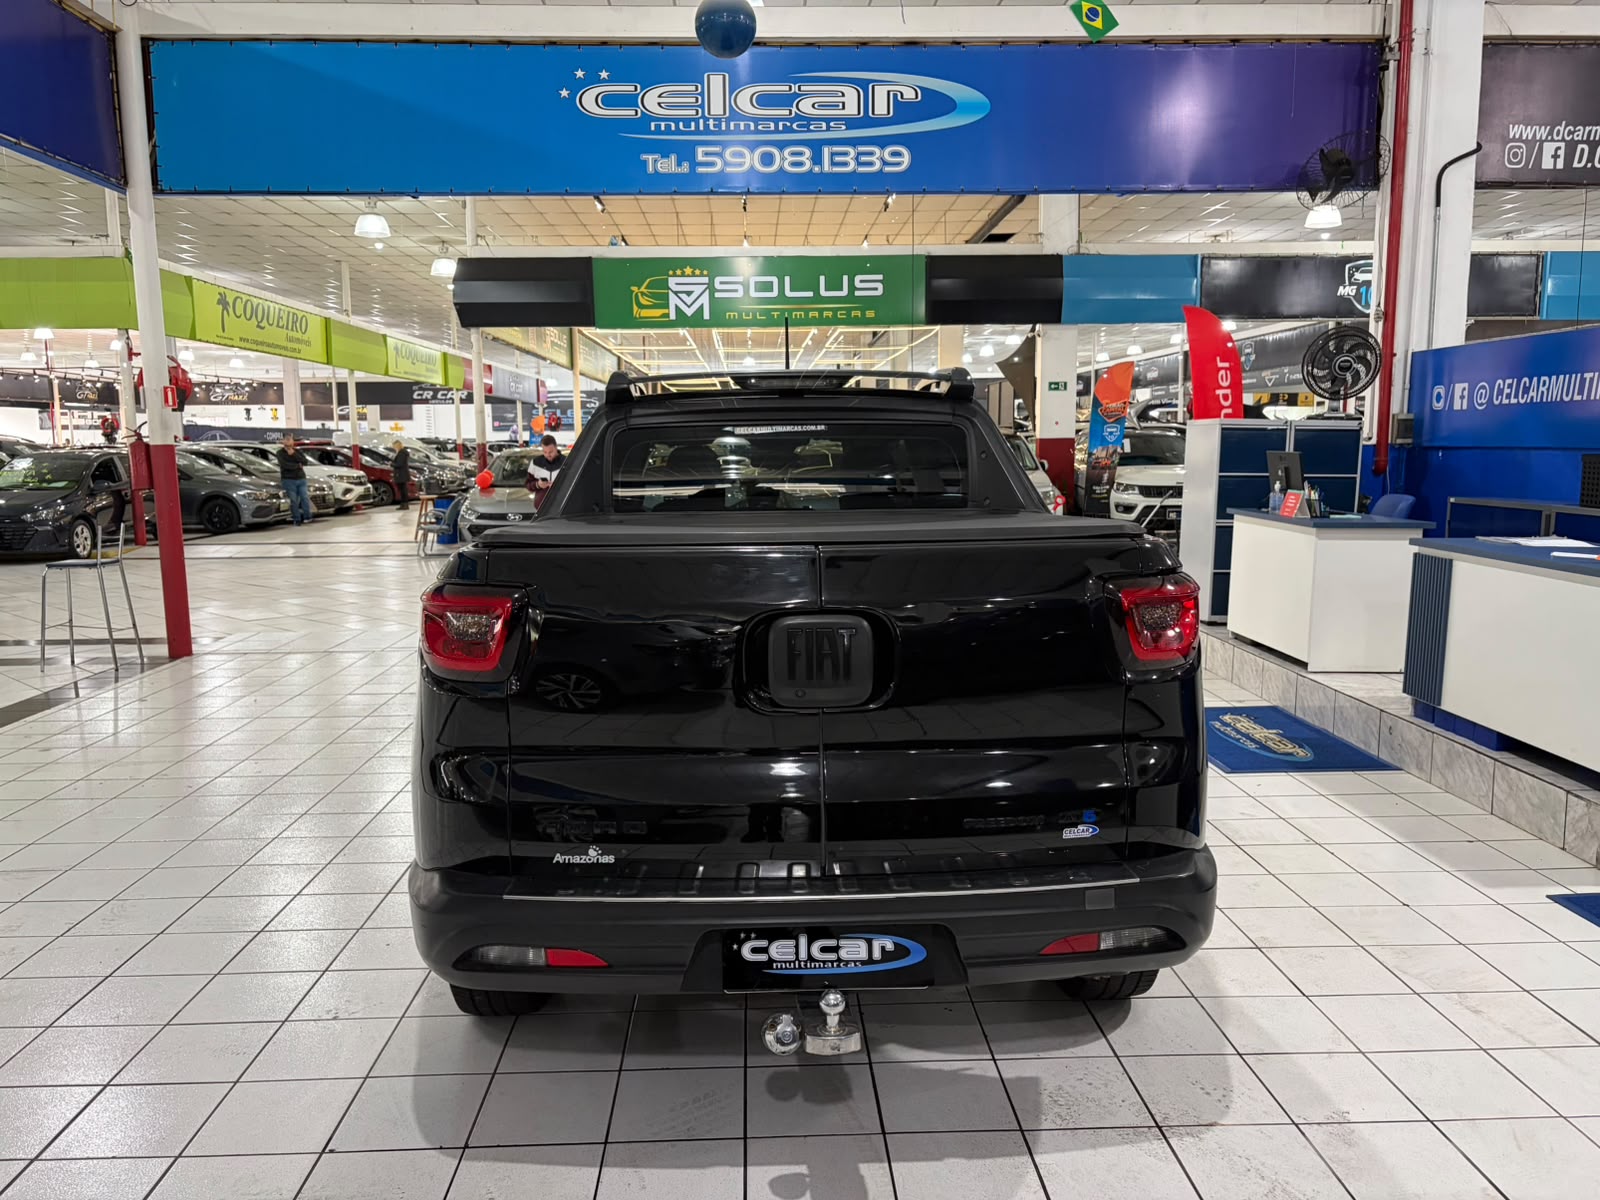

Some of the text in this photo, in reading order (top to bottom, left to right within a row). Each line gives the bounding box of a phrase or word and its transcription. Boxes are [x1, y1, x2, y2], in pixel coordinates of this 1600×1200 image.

[576, 72, 921, 118] celcar
[649, 118, 847, 132] multimarcas
[641, 145, 912, 174] Tel.: 5908.1339
[713, 274, 884, 298] SOLUS
[1337, 286, 1357, 297] MG
[231, 295, 309, 335] COQUEIRO
[725, 310, 876, 320] MULTIMARCAS
[400, 342, 437, 368] COQUEIRO
[412, 390, 433, 400] CR
[787, 628, 856, 681] FIAT
[1064, 827, 1091, 836] CELCAR
[552, 853, 616, 864] Amazonas
[740, 933, 895, 961] celcar
[772, 960, 863, 969] multimarcas
